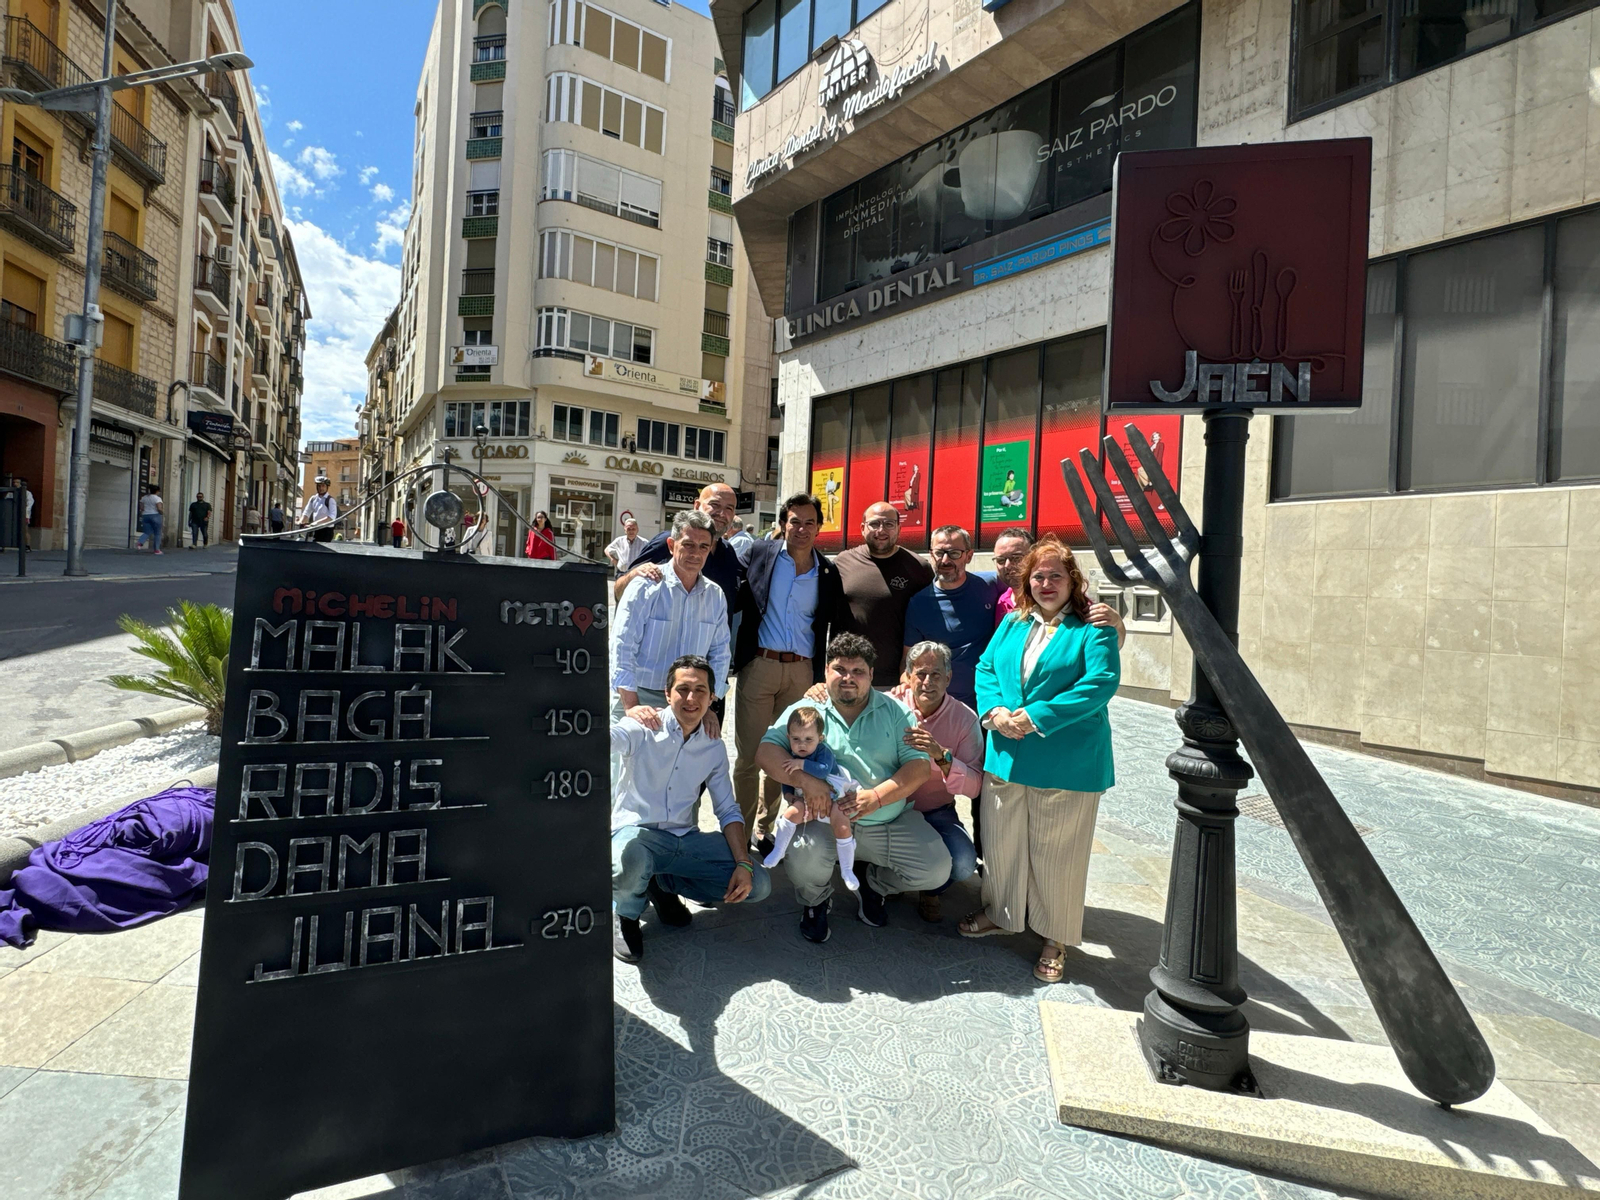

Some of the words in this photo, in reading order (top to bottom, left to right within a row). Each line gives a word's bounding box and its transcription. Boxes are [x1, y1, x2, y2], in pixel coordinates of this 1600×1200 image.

[783, 116, 824, 156] Dental
[828, 114, 838, 136] y
[843, 40, 938, 120] Maxilofacial
[818, 65, 869, 107] UNIVER
[1036, 127, 1084, 163] SAIZ
[1090, 85, 1177, 140] PARDO
[1057, 129, 1142, 172] ESTHETICS
[843, 214, 885, 239] DIGITAL
[1059, 233, 1093, 254] PINOS
[785, 298, 861, 339] CLINICA
[868, 261, 961, 312] DENTAL
[616, 364, 657, 384] Orienta
[1150, 350, 1311, 403] JAÉN
[472, 445, 529, 460] OCASO
[605, 455, 664, 476] OCASO
[672, 467, 726, 483] SEGUROS
[567, 479, 600, 489] PRONOVIAS
[250, 618, 473, 673] MALAK
[555, 648, 591, 675] 40
[245, 683, 433, 744] BAGÁ
[544, 709, 593, 737] 150
[544, 769, 593, 801] 180
[232, 828, 428, 901] DAMA
[253, 896, 495, 982] JUANA
[541, 905, 595, 940] 270
